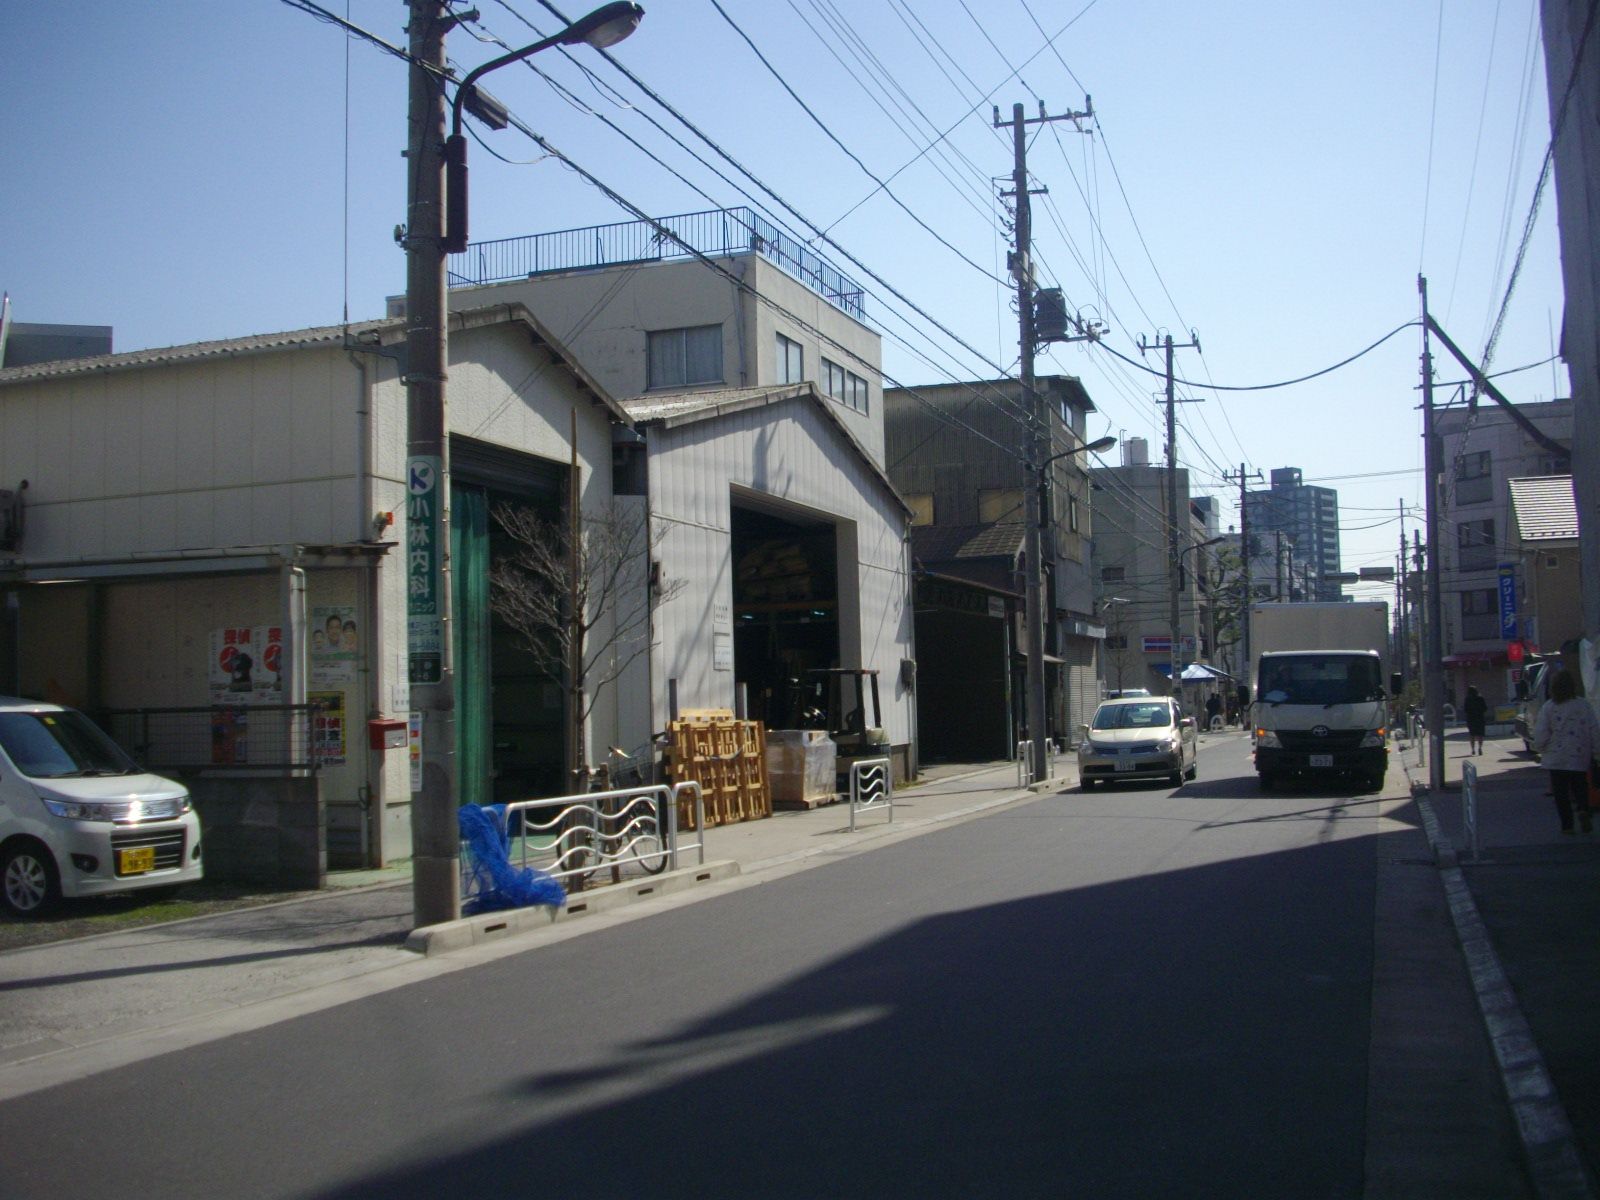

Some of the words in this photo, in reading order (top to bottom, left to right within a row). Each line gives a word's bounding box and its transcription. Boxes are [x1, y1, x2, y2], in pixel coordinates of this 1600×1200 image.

[410, 497, 430, 598] 小林内科
[1503, 578, 1514, 628] クリーニング
